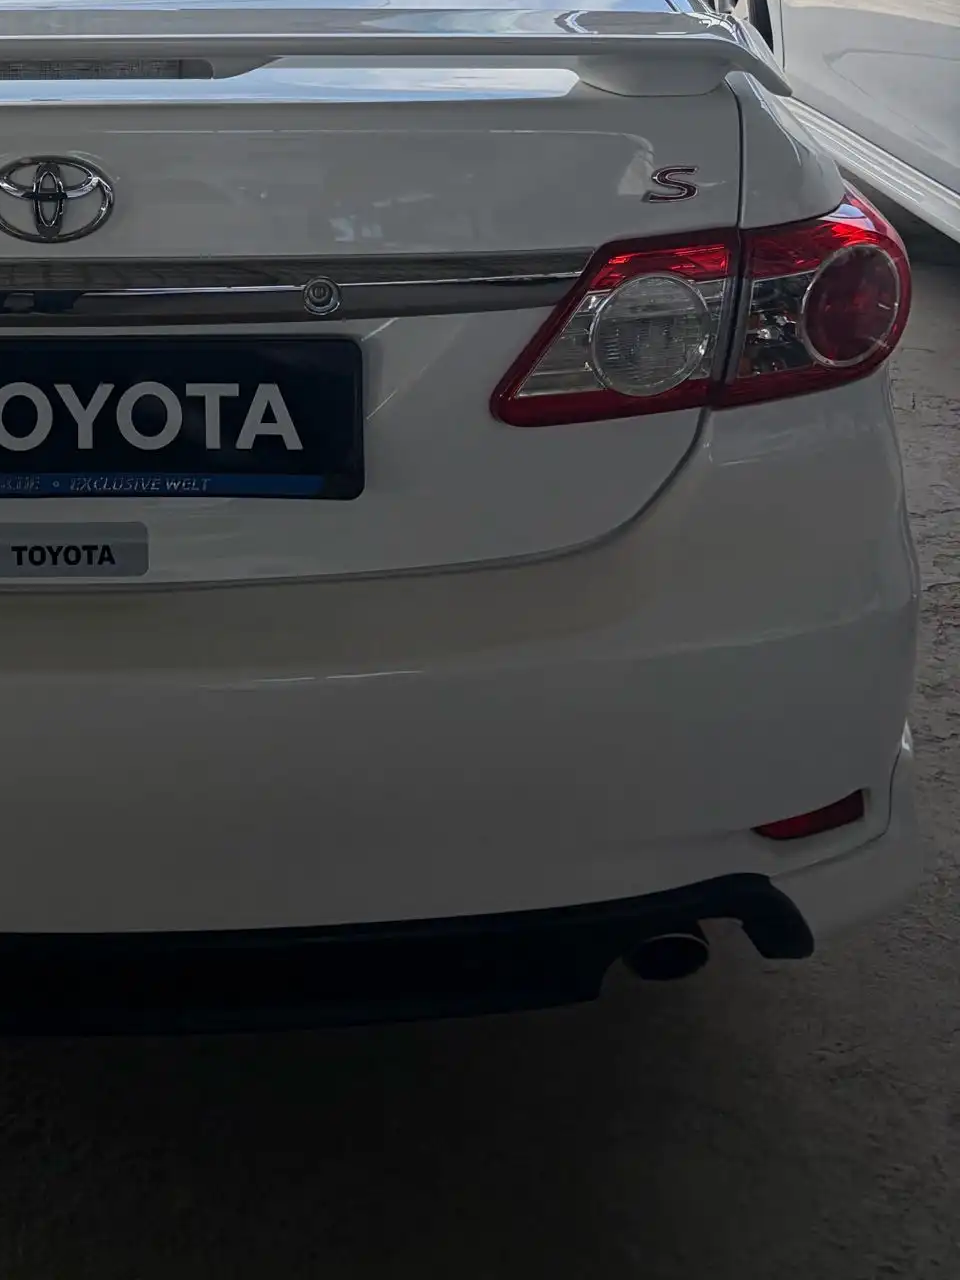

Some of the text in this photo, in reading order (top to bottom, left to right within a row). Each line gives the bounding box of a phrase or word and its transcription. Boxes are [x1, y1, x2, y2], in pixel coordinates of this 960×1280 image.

[642, 166, 698, 203] S
[70, 476, 212, 492] EXCLUSIVE WELT
[11, 544, 116, 567] TOYOTA
